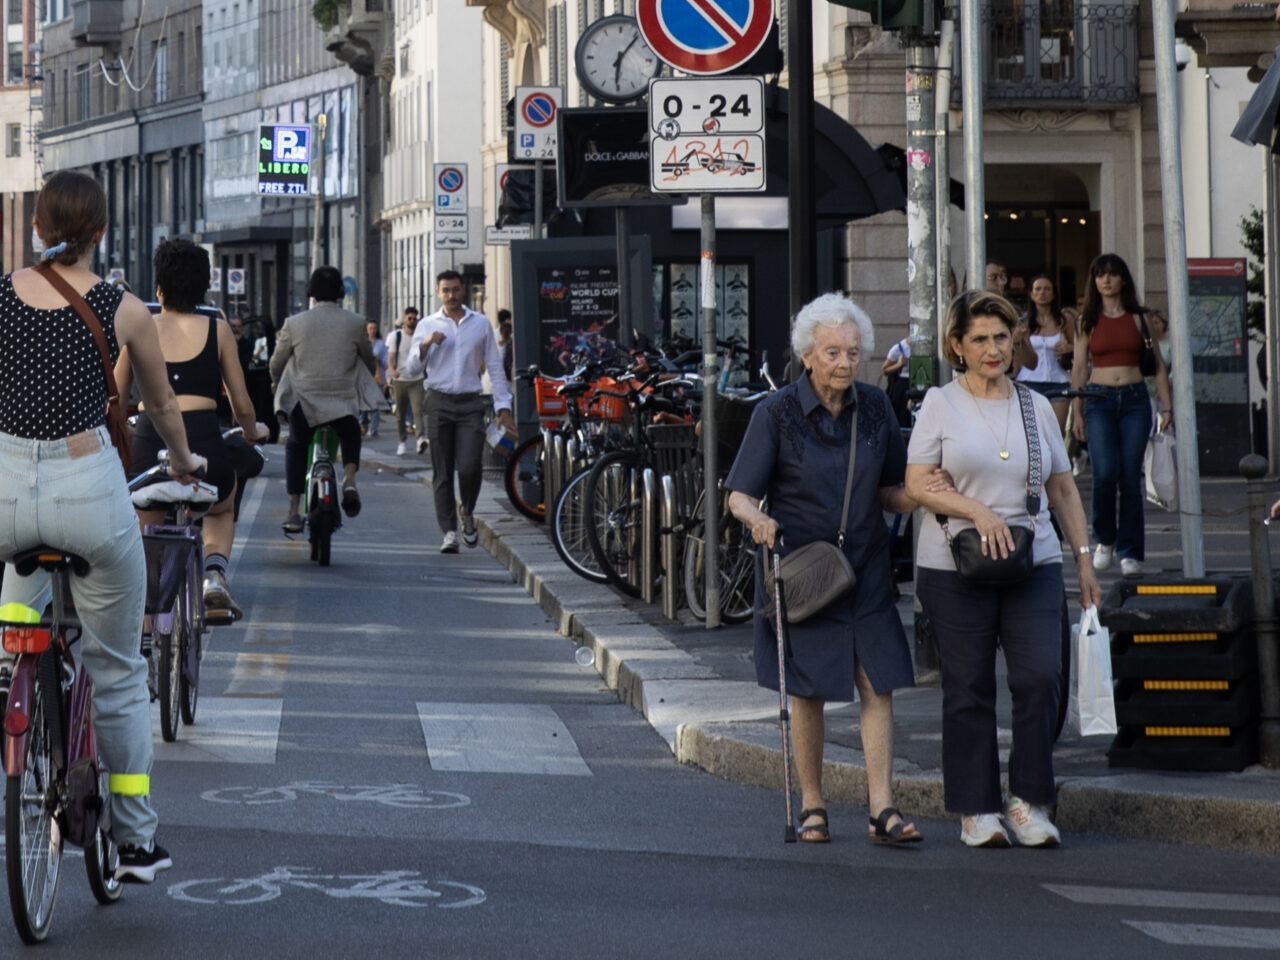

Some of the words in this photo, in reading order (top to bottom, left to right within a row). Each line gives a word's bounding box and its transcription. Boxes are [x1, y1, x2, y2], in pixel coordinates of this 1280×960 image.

[663, 95, 683, 118] 0
[709, 94, 751, 117] 24
[277, 130, 298, 159] P
[523, 136, 532, 145] P
[541, 149, 554, 157] 24
[585, 152, 611, 162] DOLCE
[259, 162, 309, 174] LIBERO
[259, 182, 285, 193] FREE
[288, 183, 307, 194] ZTL
